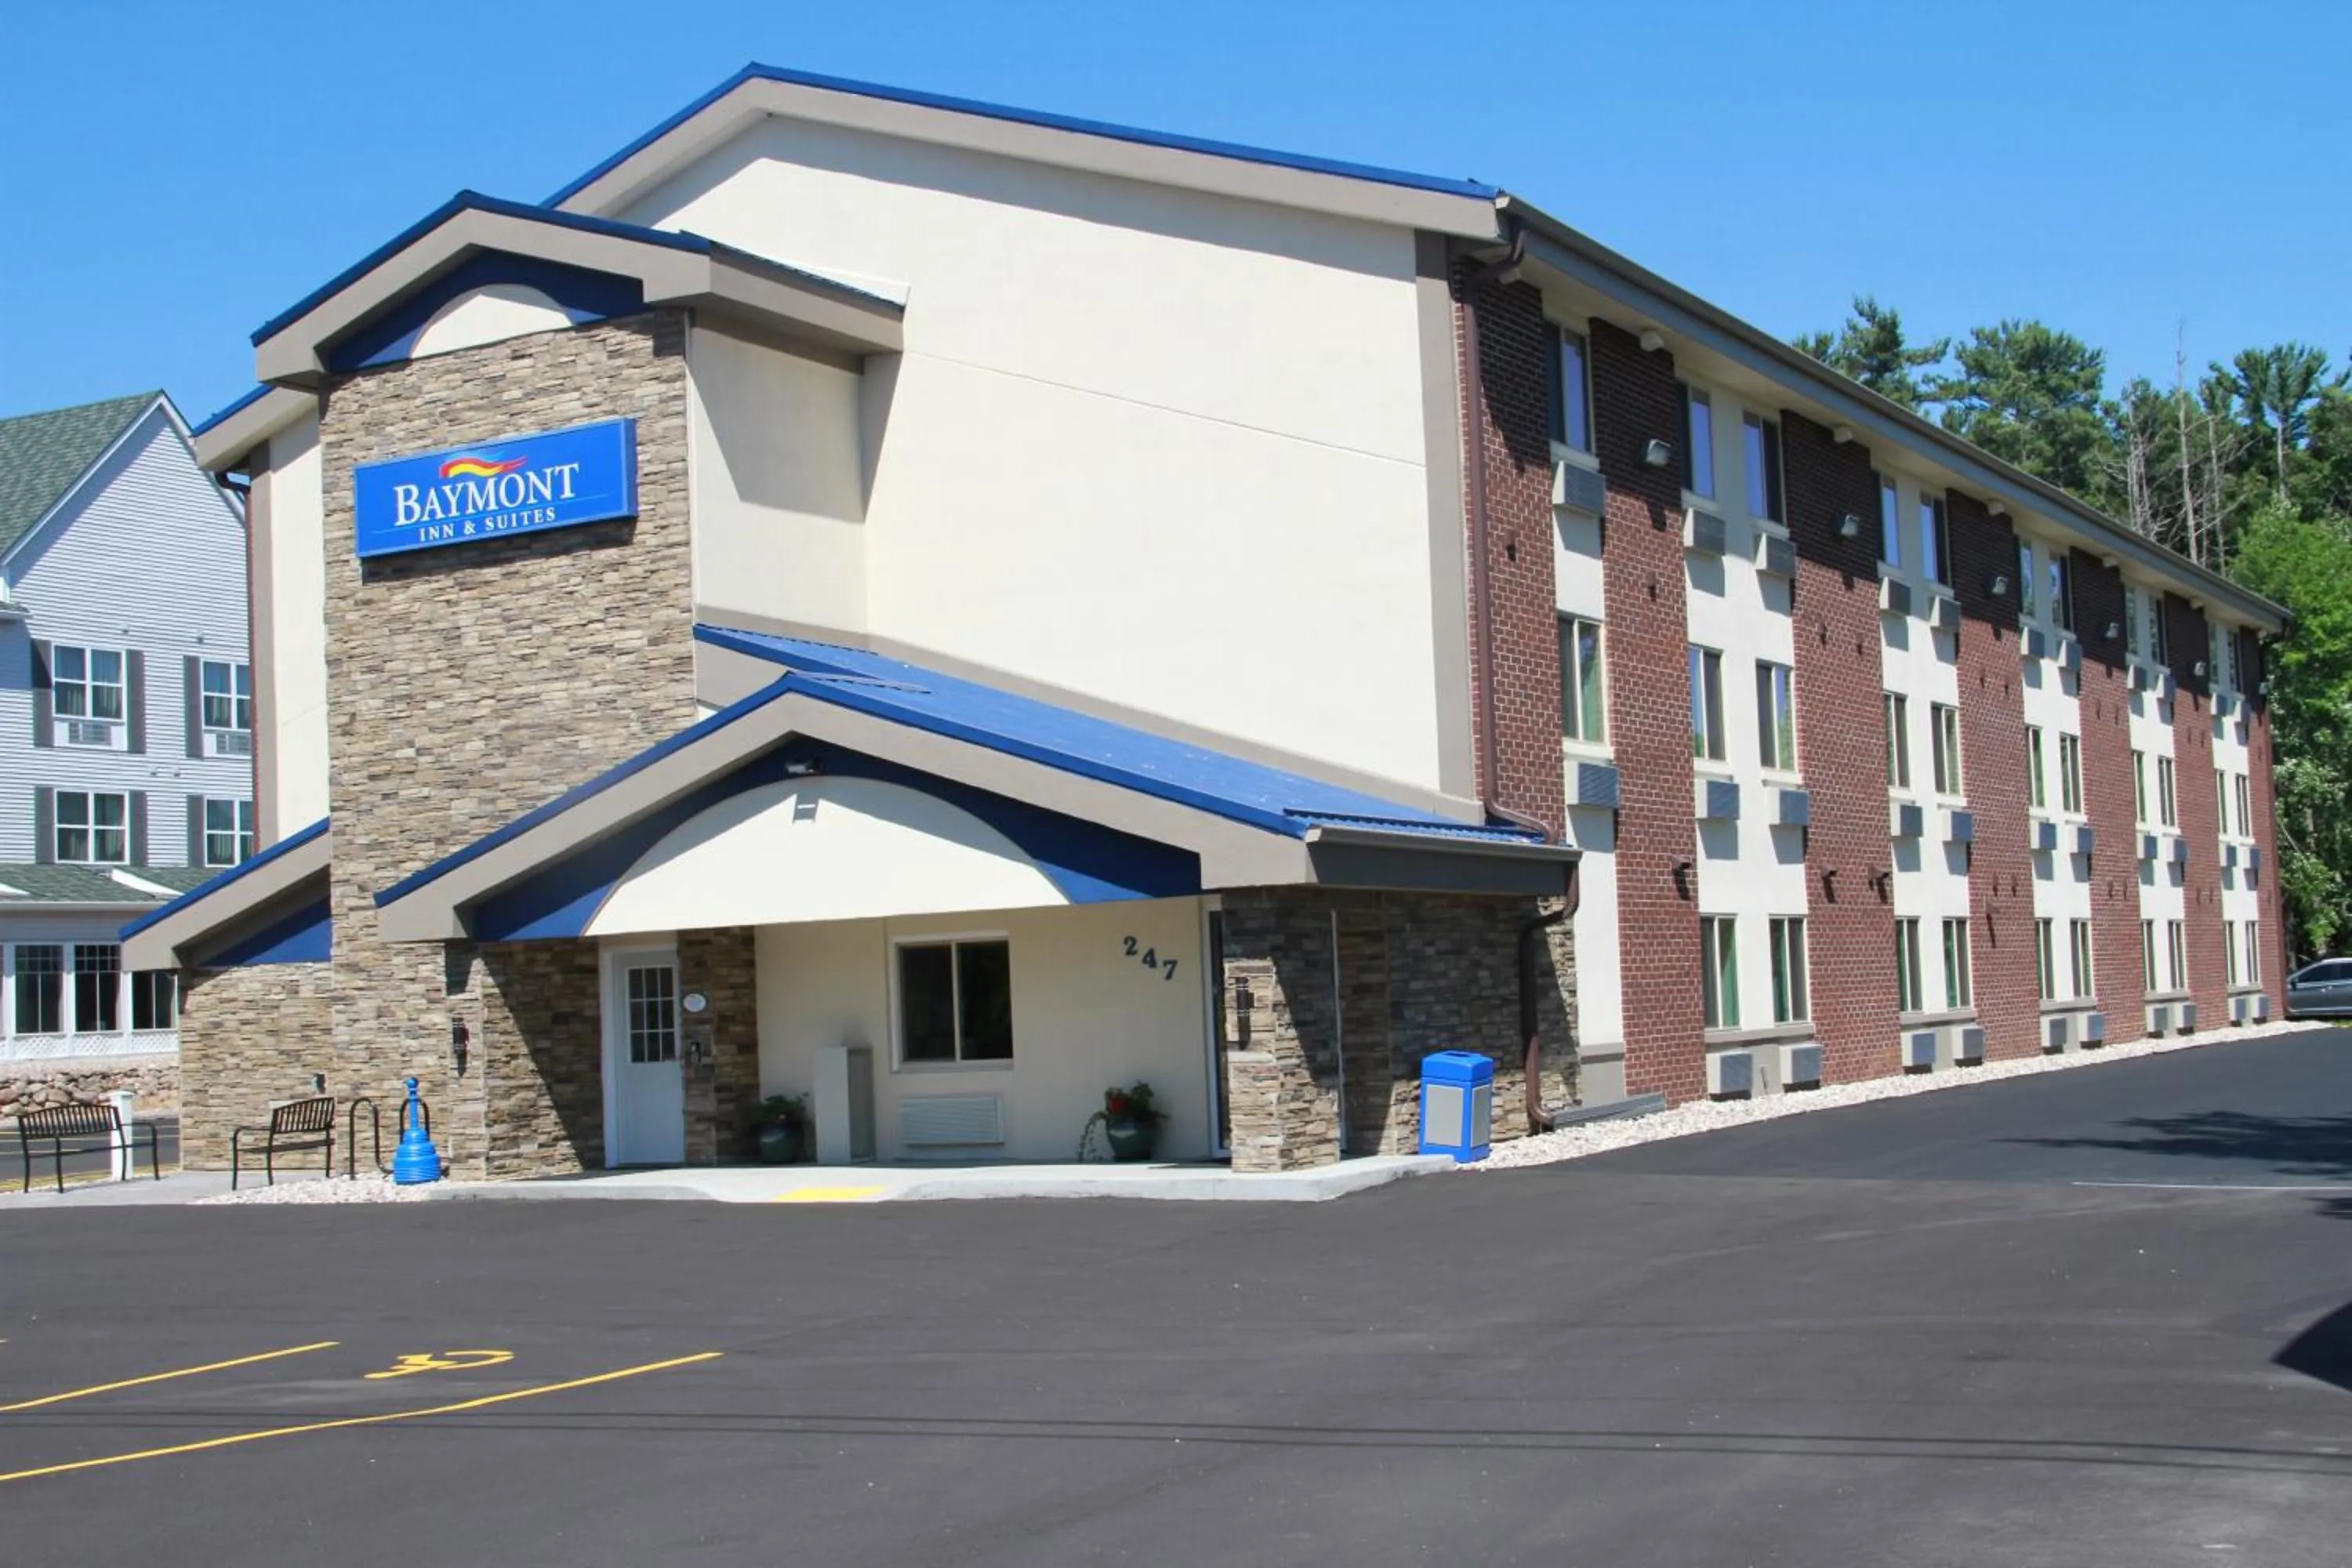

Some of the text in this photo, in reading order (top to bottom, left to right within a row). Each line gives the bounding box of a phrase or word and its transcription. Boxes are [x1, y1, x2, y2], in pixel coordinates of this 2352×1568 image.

[394, 463, 579, 526] BAYMONT
[419, 507, 557, 542] INN & SUITES
[1123, 935, 1178, 980] 247
